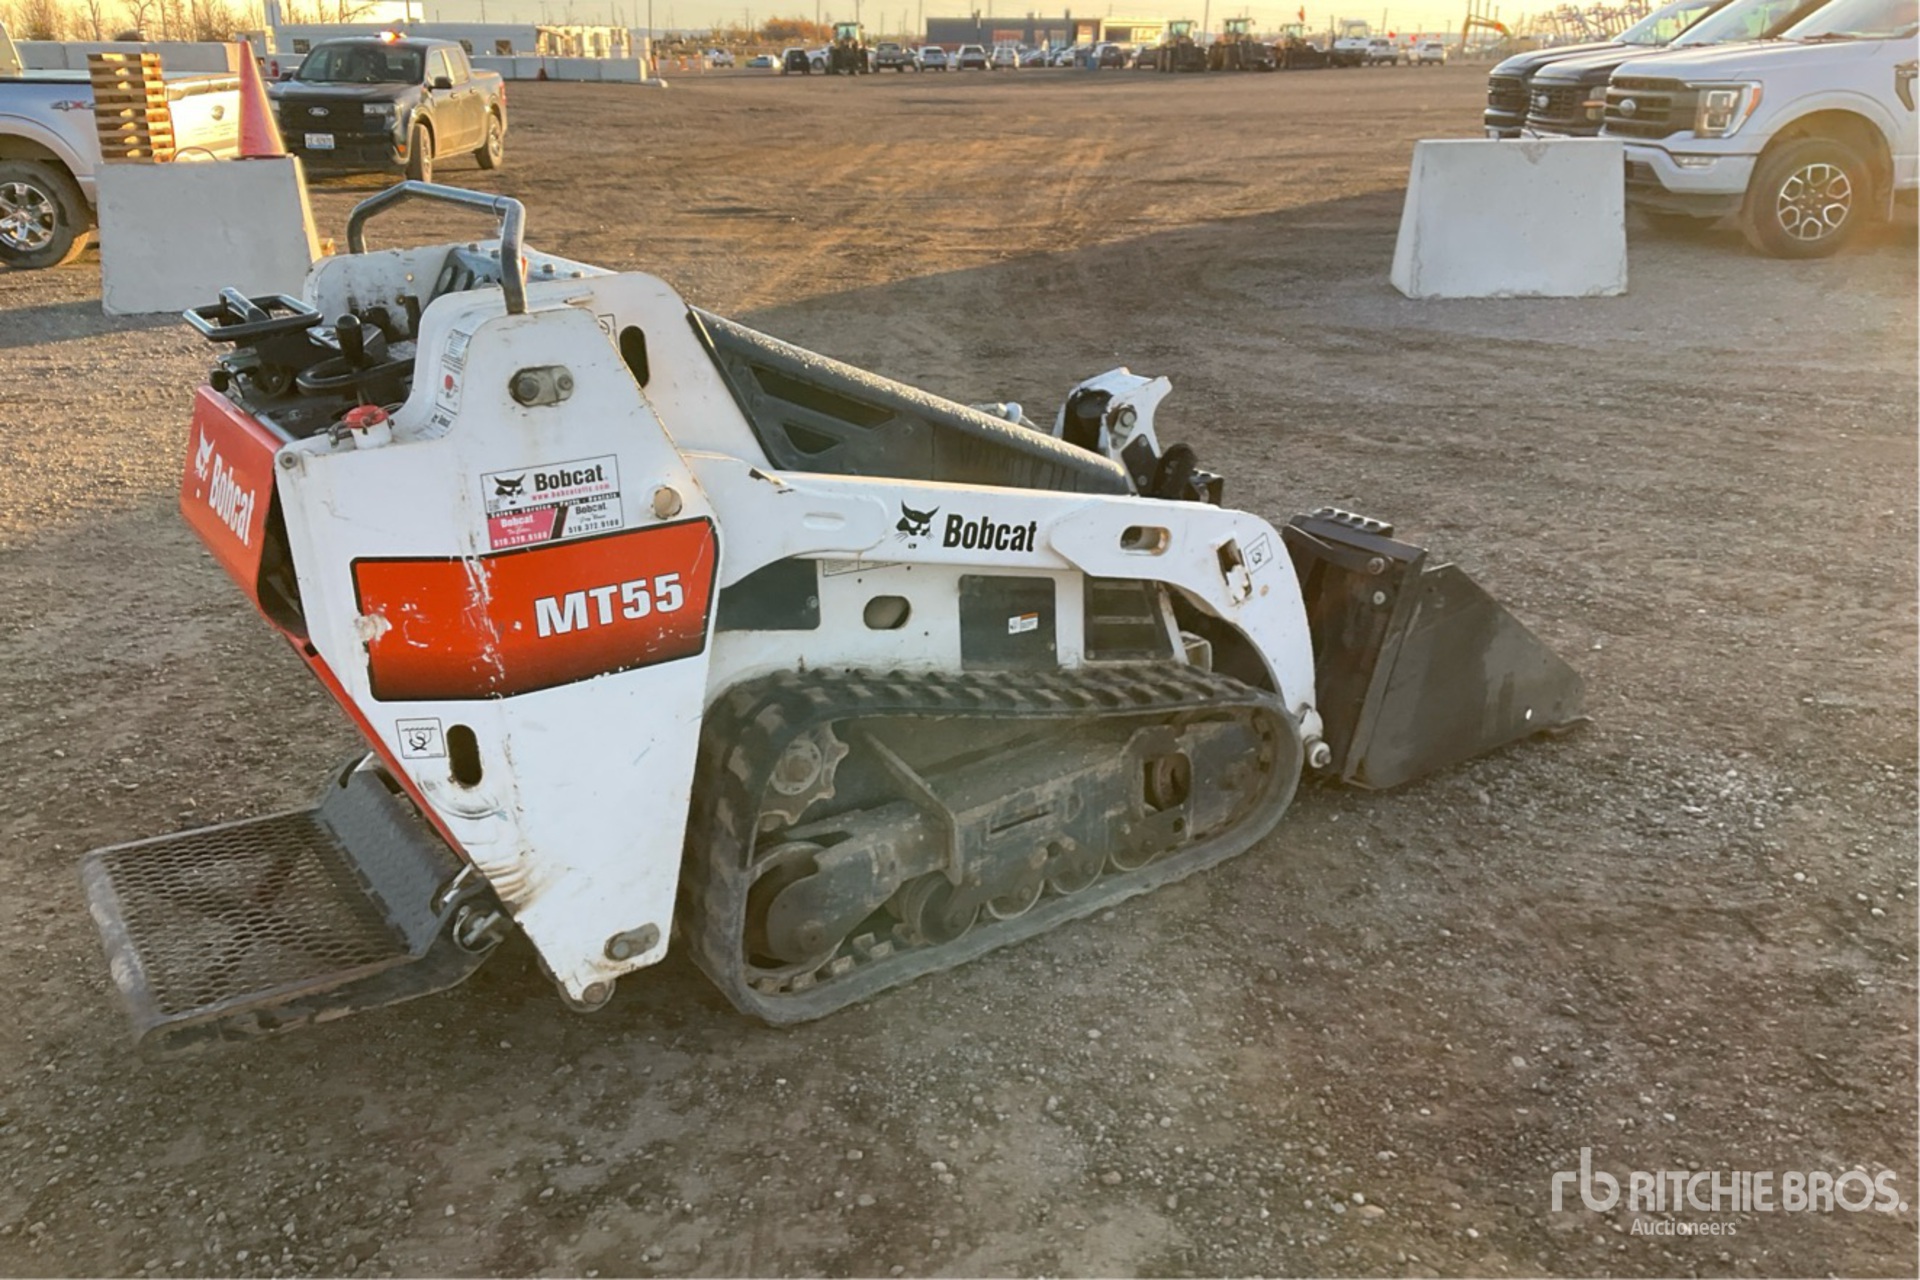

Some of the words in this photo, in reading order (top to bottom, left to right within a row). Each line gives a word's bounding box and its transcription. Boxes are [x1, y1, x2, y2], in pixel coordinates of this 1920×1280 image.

[534, 464, 604, 492] Bobcat
[208, 453, 255, 546] Bobcat
[576, 502, 606, 516] Bobcat
[943, 514, 1037, 552] Bobcat
[534, 572, 684, 639] MT55
